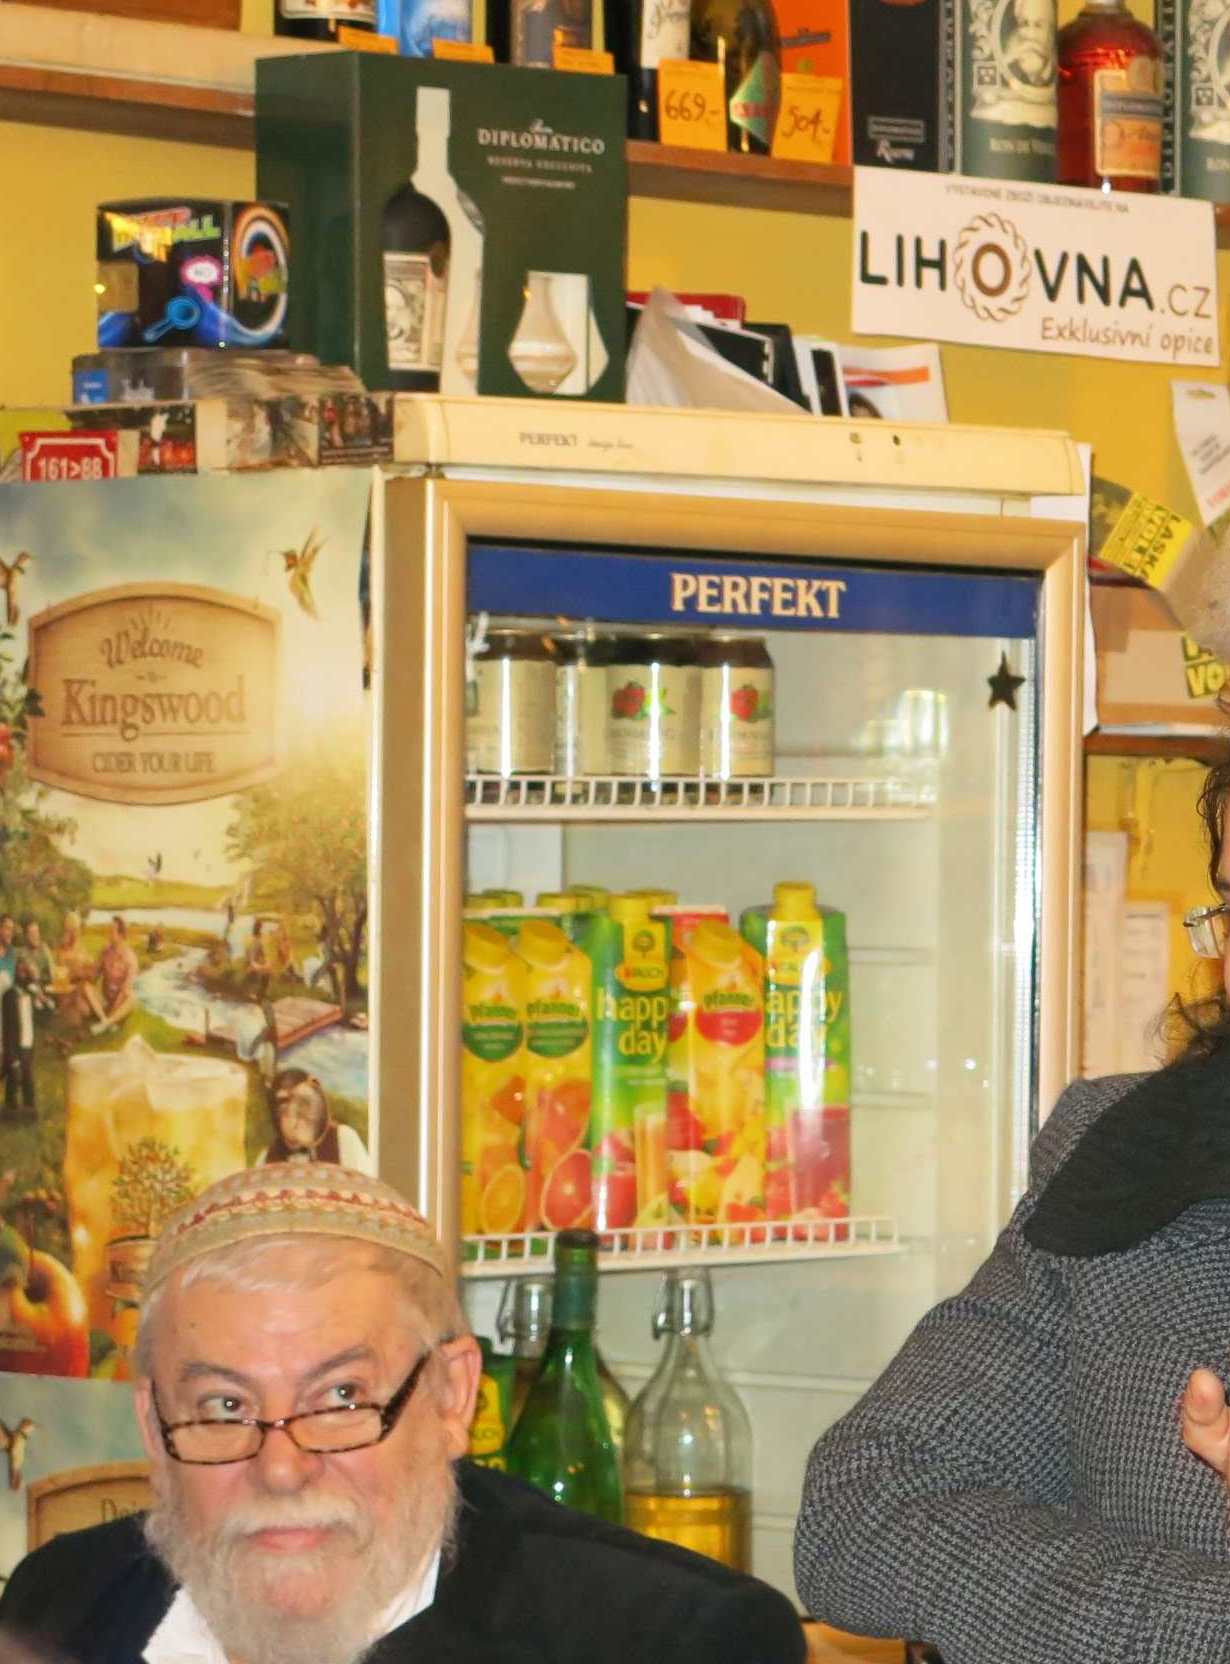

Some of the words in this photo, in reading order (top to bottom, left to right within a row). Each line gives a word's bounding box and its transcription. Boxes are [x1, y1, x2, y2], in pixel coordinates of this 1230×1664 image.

[860, 229, 1213, 319] LIHOVNA.CZ
[1161, 328, 1214, 359] opice
[670, 572, 846, 619] PERFEKT
[100, 626, 204, 669] Welcome
[61, 674, 246, 742] Kingswood
[92, 751, 137, 774] CIDER
[139, 751, 182, 774] YOUR
[185, 751, 216, 774] LIFE
[596, 986, 668, 1029] happ
[618, 1027, 666, 1065] day
